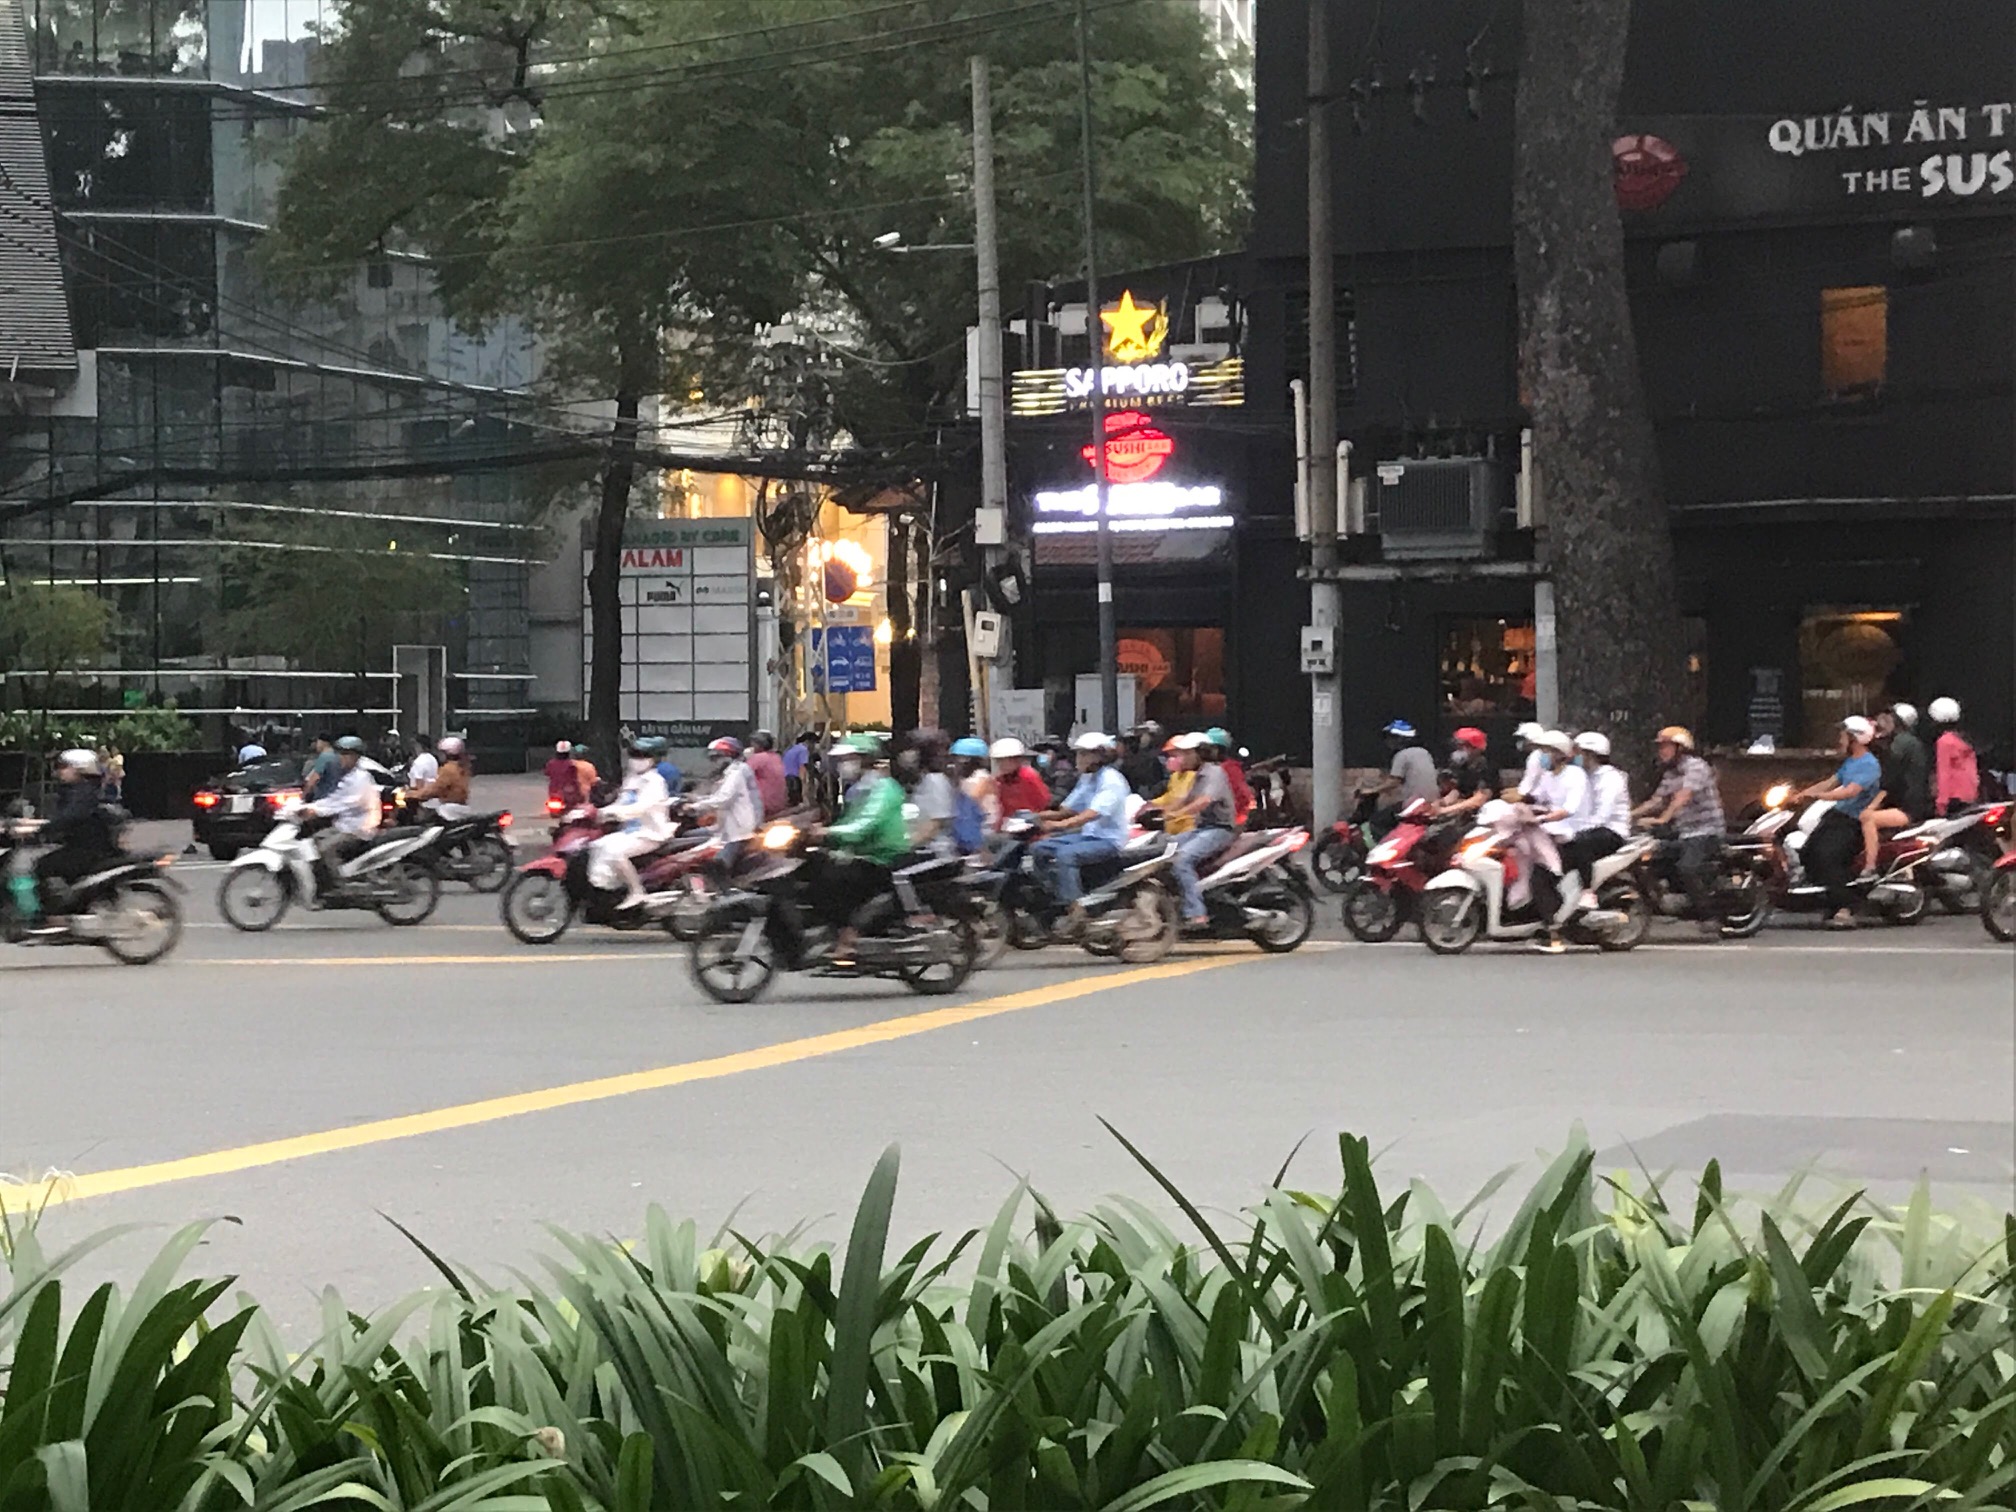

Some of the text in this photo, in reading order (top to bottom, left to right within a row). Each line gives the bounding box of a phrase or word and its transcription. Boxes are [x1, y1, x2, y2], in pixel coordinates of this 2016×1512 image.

[1768, 99, 2016, 156] QUÁN ĂN T
[1842, 167, 1911, 194] THE
